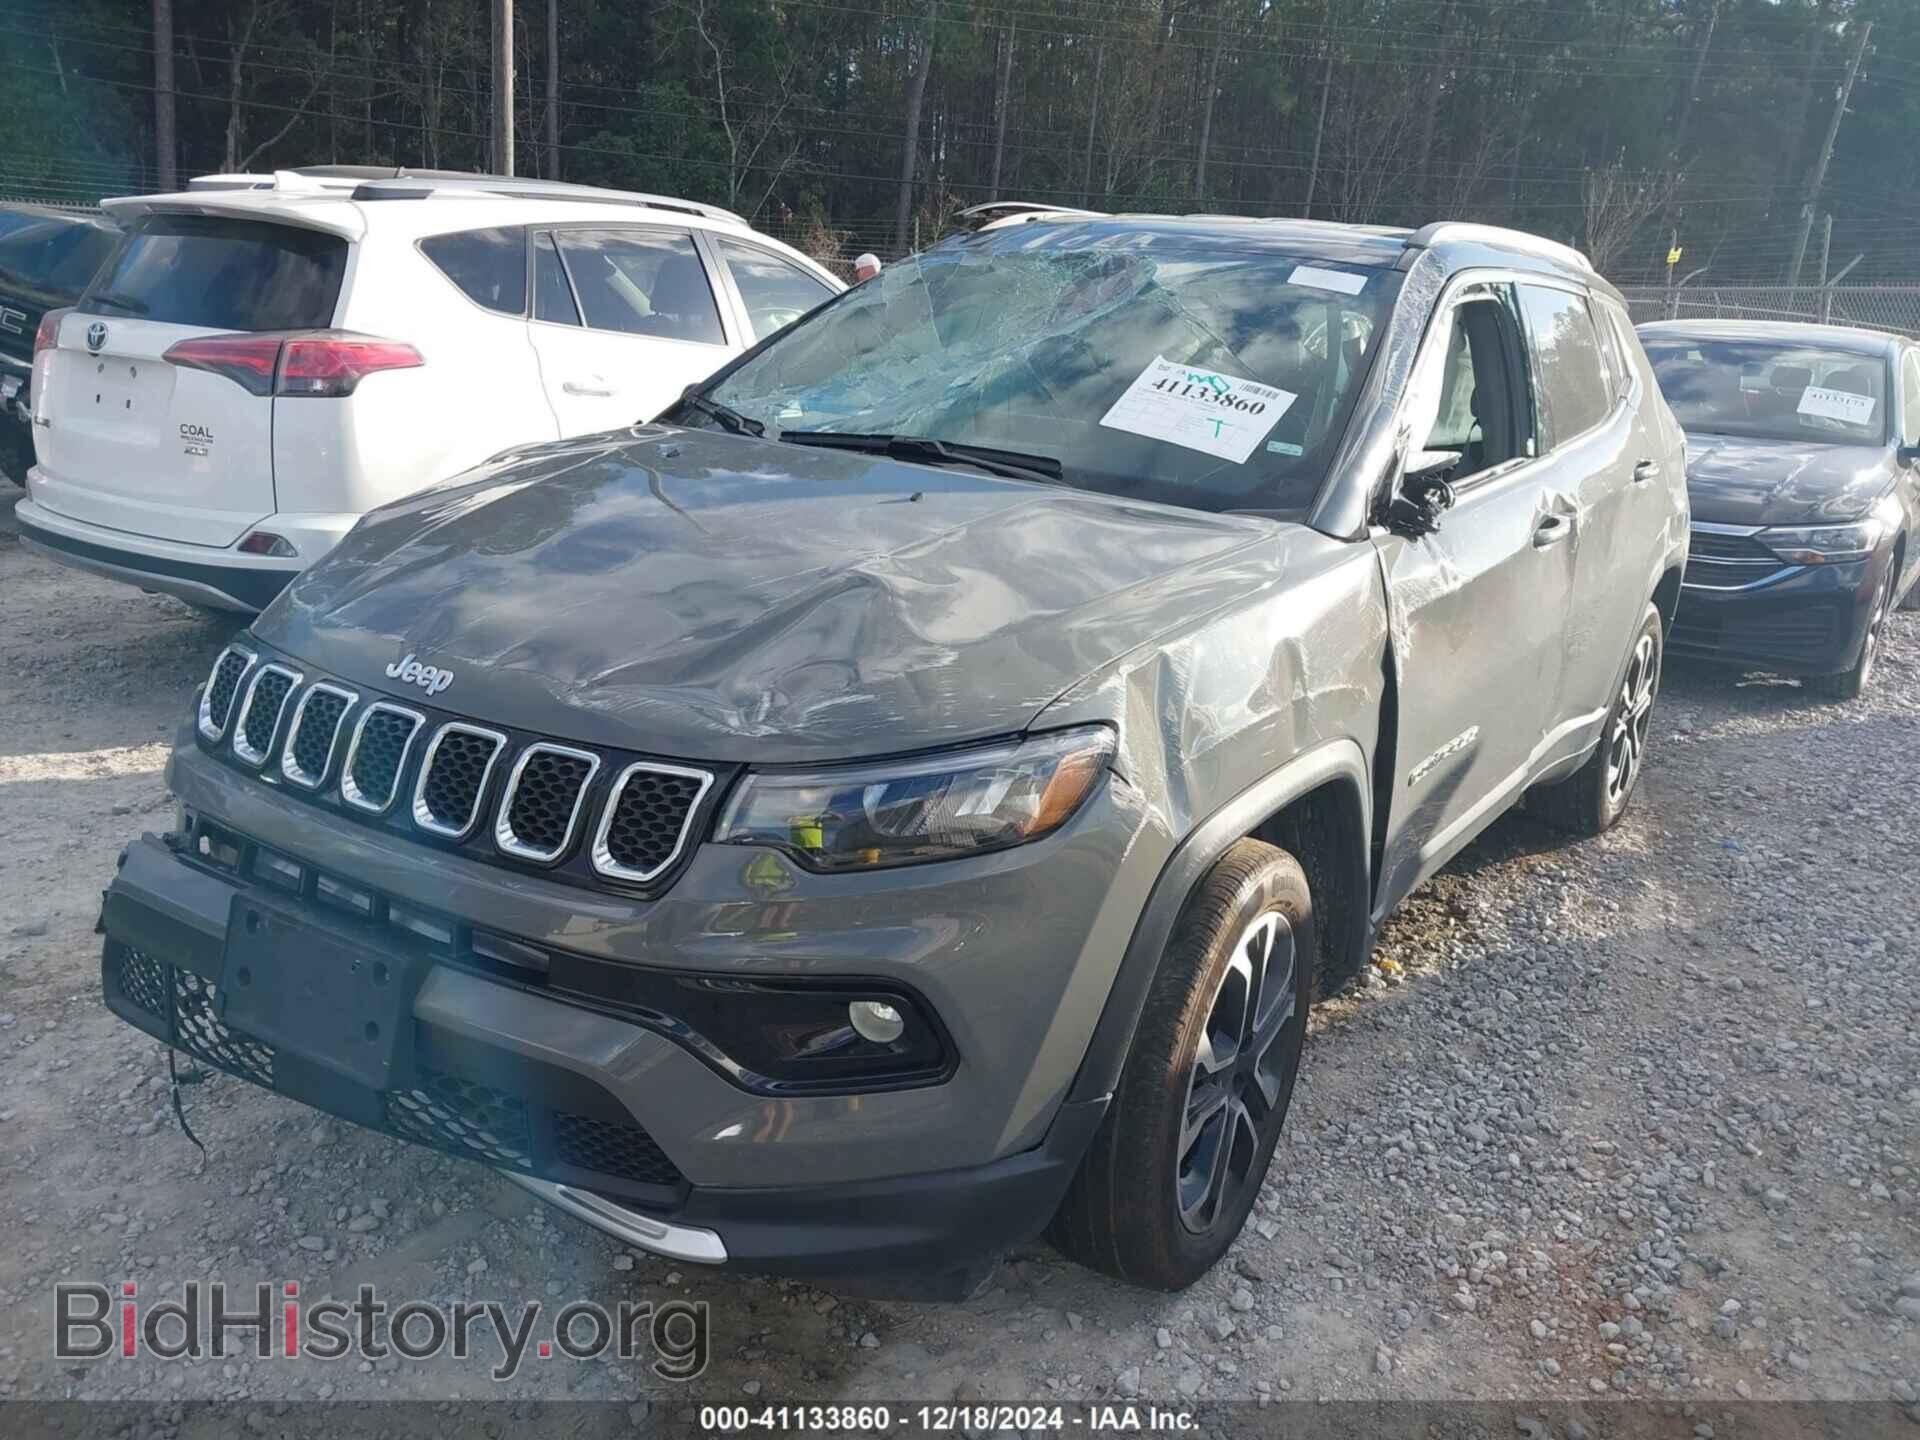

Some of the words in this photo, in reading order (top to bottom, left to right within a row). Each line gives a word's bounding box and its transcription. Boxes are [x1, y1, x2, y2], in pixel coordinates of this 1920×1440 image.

[1152, 378, 1266, 416] 41133860
[180, 423, 214, 439] COAL
[385, 653, 454, 697] Jeep
